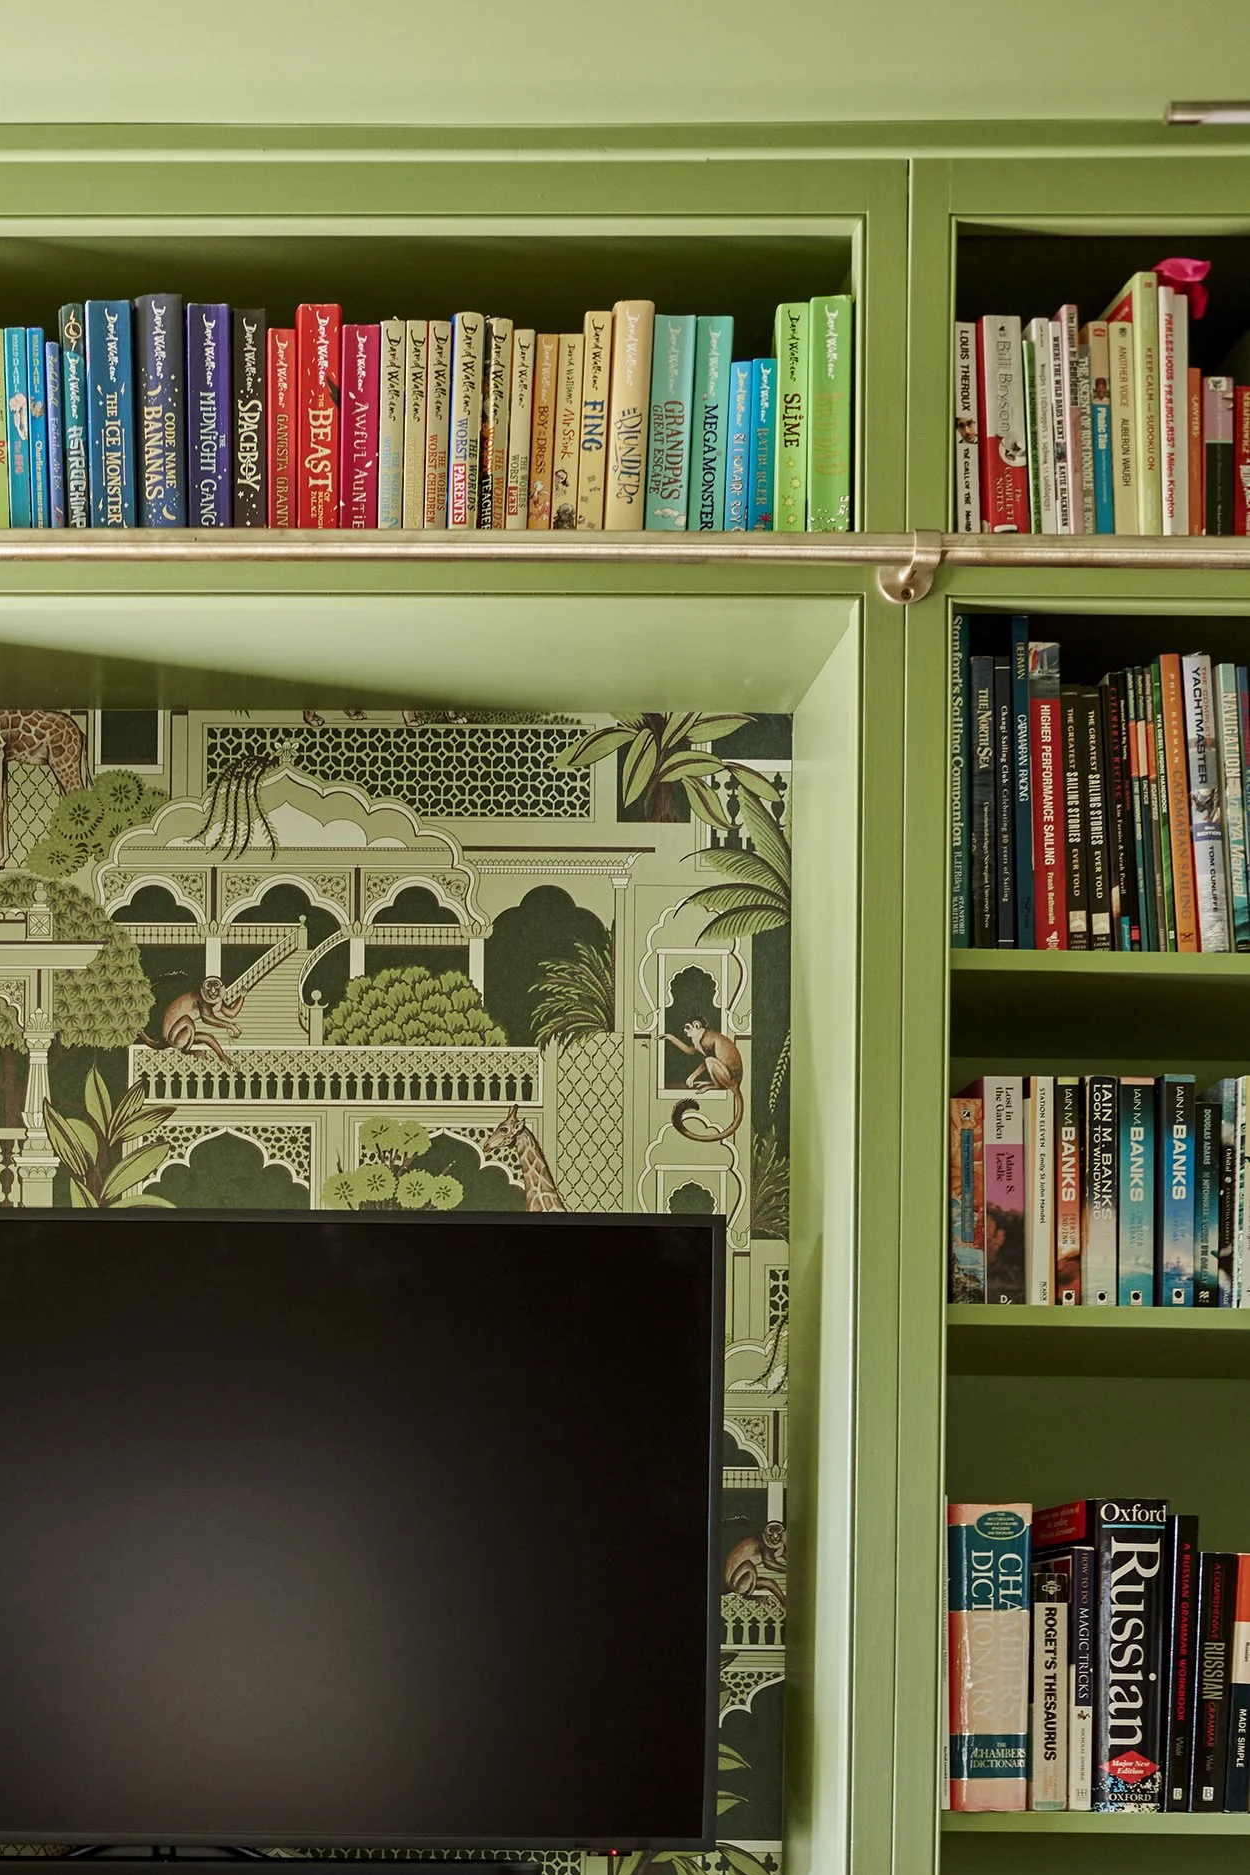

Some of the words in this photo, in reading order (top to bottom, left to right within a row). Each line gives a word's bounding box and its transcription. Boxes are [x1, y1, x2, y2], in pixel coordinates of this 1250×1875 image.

[960, 330, 969, 360] LOUIS
[996, 340, 1011, 369] Bill
[1119, 346, 1129, 383] ANOTHER
[106, 392, 117, 417] THE
[961, 365, 970, 411] THEROUX
[997, 373, 1013, 432] Bryson
[1120, 385, 1129, 407] VOICE
[105, 420, 121, 447] ICE
[164, 412, 176, 448] CODE
[455, 418, 467, 461] WORST
[581, 399, 604, 452] FING
[652, 405, 665, 444] GREAT
[1120, 418, 1130, 456] AUBERON
[144, 405, 164, 500] BANANAS
[237, 399, 262, 491] SPACEBOY
[660, 400, 685, 500] GRANDPA'S
[165, 452, 177, 489] NAME
[650, 448, 664, 494] ESCAPE
[1122, 457, 1131, 487] WAUGH
[1167, 452, 1175, 478] Miles
[106, 452, 122, 525] MONSTER
[454, 464, 465, 523] PARENTS
[996, 478, 1004, 512] NOTES
[1004, 467, 1013, 522] COMPLETE
[1166, 479, 1175, 518] Kington
[1041, 704, 1051, 742] HIGHER
[1191, 667, 1208, 784] YACHTMASTER
[1222, 692, 1240, 778] NAVIGATION
[1067, 726, 1076, 769] GREATEST
[1041, 745, 1053, 822] PERFORMANCE
[1066, 772, 1079, 806] SAILING
[1043, 824, 1055, 865] SAILING
[1067, 808, 1080, 843] STORIES
[1072, 848, 1080, 870] EVER
[1073, 873, 1081, 896] TOLD
[1092, 1084, 1101, 1122] LOOK
[1101, 1083, 1112, 1120] IAIN
[1092, 1126, 1101, 1144] TO
[1102, 1127, 1112, 1148] M.
[996, 1152, 1005, 1181] Leslie
[1006, 1152, 1015, 1181] Adam
[1092, 1144, 1102, 1219] WINDWARD
[1101, 1153, 1112, 1220] BANKS
[1100, 1503, 1167, 1523] Oxford
[1044, 1607, 1057, 1673] ROGET'S
[1107, 1536, 1162, 1746] Russian
[1202, 1642, 1225, 1700] RUSSIAN
[1044, 1674, 1057, 1762] THESAURUS
[1205, 1701, 1216, 1748] GRAMMAR
[1238, 1709, 1247, 1733] MADE
[970, 1758, 1025, 1768] DICTIONARY
[1117, 1767, 1144, 1775] Edition
[1235, 1736, 1247, 1769] SIMPLE
[1109, 1792, 1151, 1801] OXFORD
